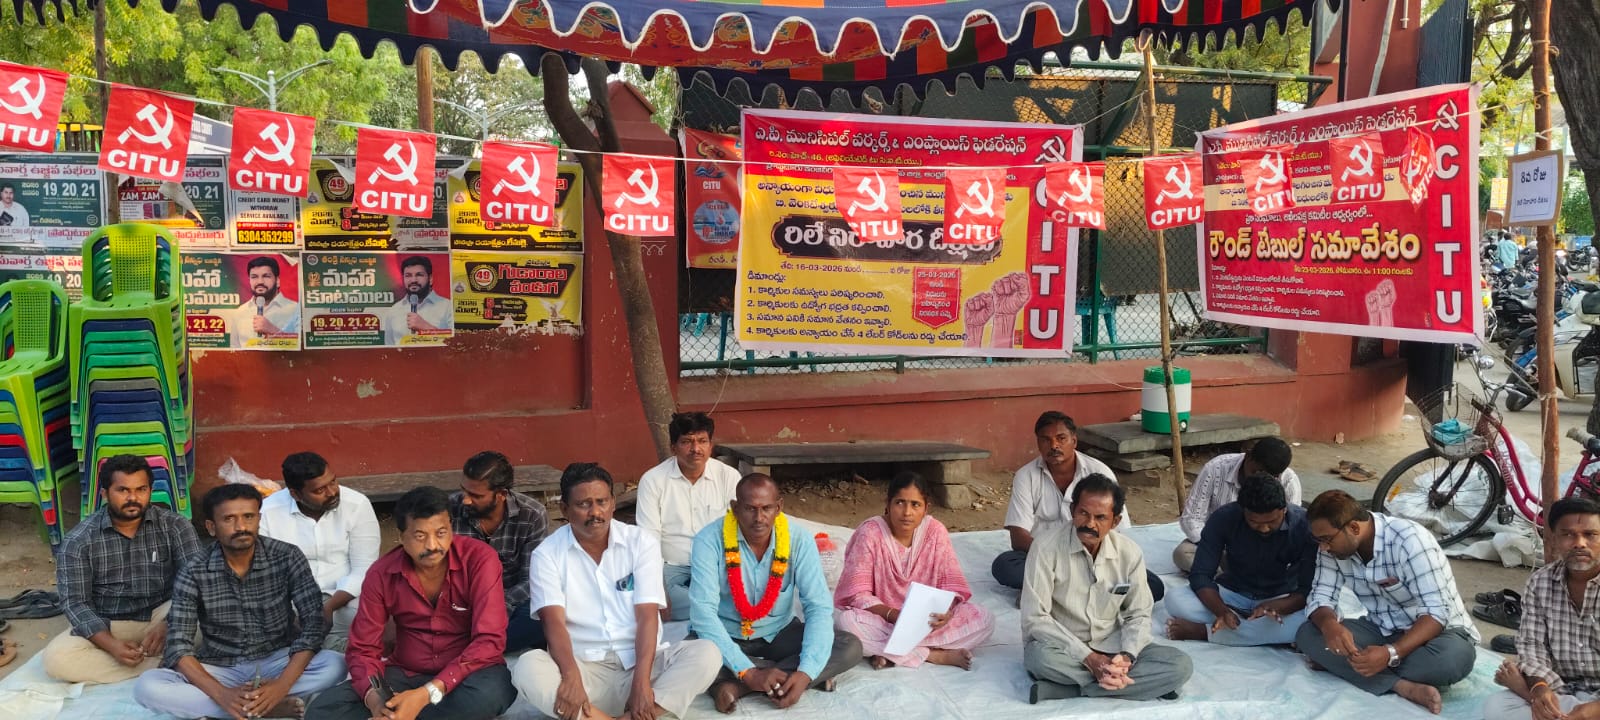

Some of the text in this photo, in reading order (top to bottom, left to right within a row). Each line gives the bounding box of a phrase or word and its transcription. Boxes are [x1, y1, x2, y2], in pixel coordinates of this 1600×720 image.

[0, 123, 49, 147] ITU
[786, 129, 851, 147] మునిసిపల్
[892, 138, 900, 148] &
[107, 149, 180, 177] CITU
[235, 169, 303, 193] CITU
[329, 179, 345, 189] 49
[702, 180, 721, 190] CITU
[81, 183, 96, 197] 21
[121, 192, 160, 201] ZAM ZAM
[205, 185, 219, 199] 21
[1337, 182, 1382, 201] CITU
[361, 189, 428, 212] CITU
[486, 201, 549, 222] CITU
[1051, 209, 1101, 226] CITU
[1151, 205, 1201, 226] CITU
[609, 213, 669, 232] CITU
[238, 230, 294, 243] 6304353299
[784, 220, 824, 244] రిలే
[949, 223, 998, 241] CITU
[1209, 222, 1420, 260] రౌండ్ టేబుల్ సమావేశం
[476, 270, 491, 280] 49
[796, 263, 843, 272] 16-03-2026
[322, 267, 376, 287] మహా
[509, 279, 558, 294] పండుగ
[306, 288, 395, 304] కూటములు
[210, 319, 224, 329] 22
[364, 317, 378, 327] 22
